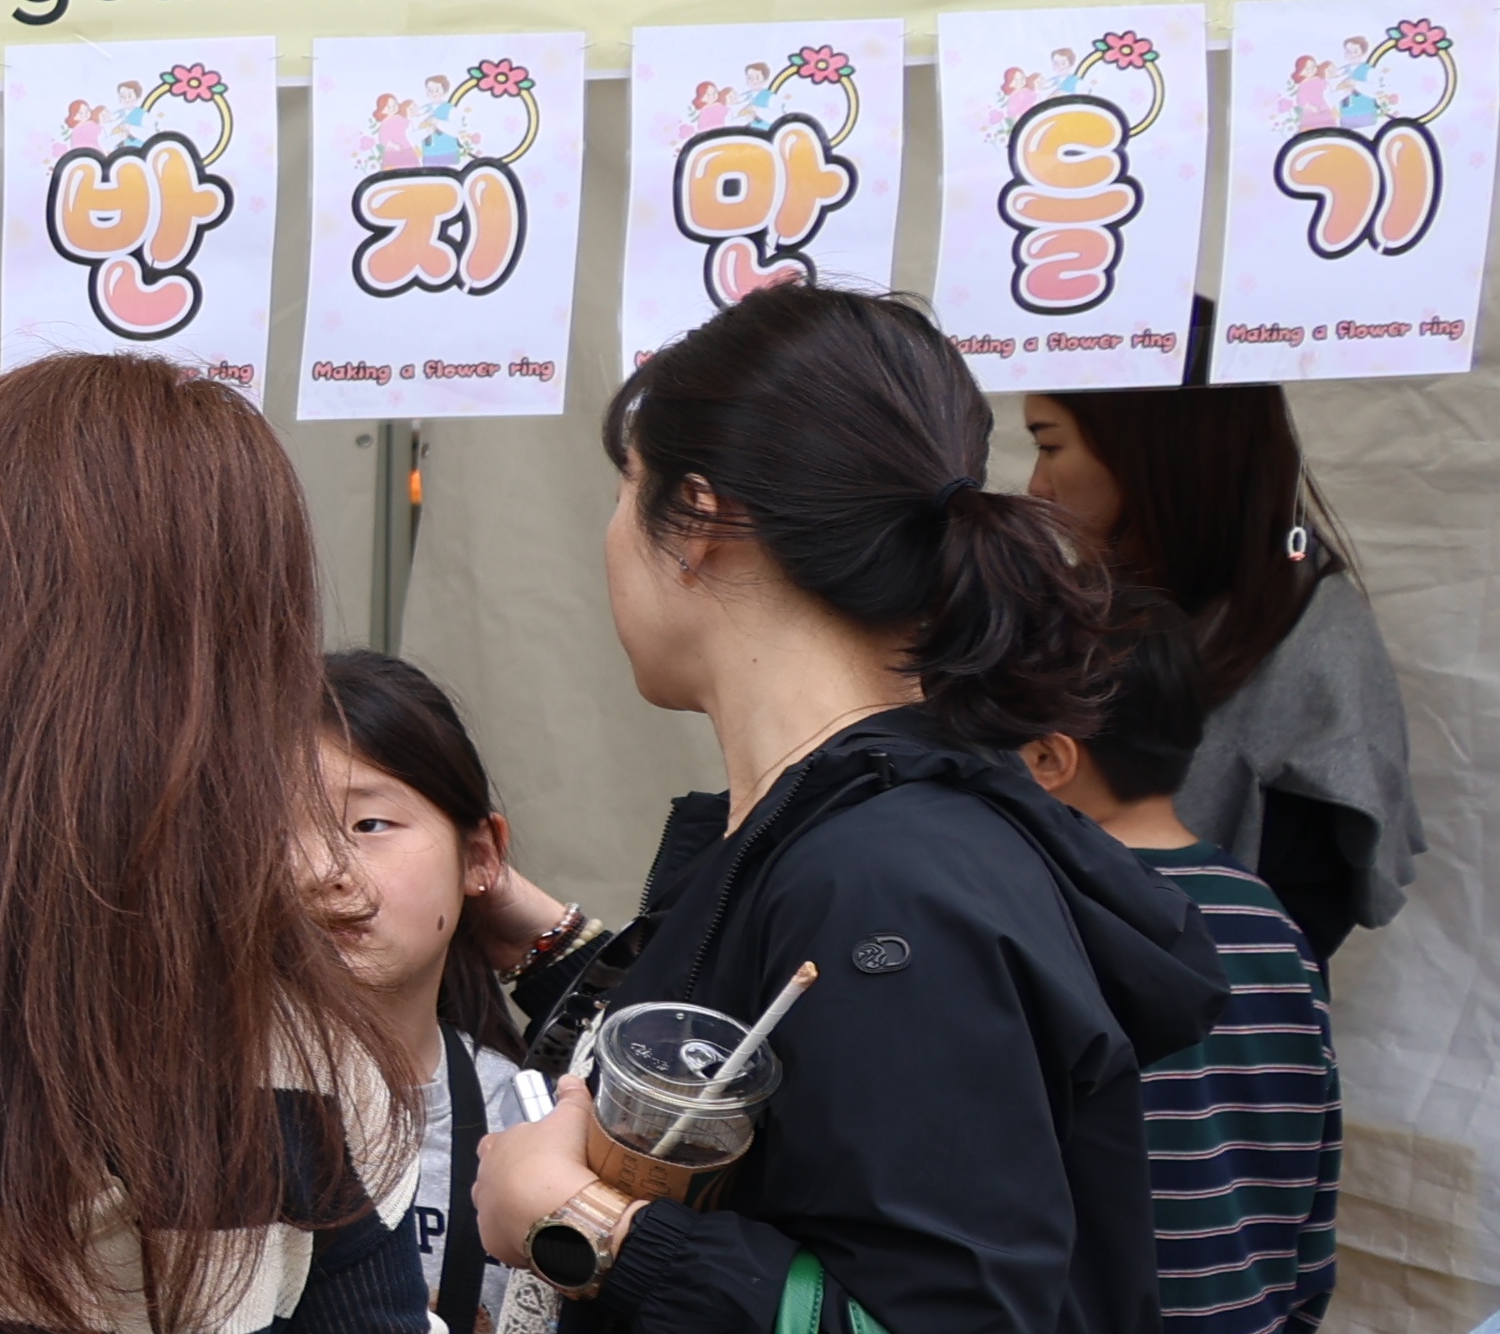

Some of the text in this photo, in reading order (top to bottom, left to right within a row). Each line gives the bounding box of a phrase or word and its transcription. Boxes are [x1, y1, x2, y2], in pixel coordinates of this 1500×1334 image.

[46, 131, 235, 340] 반
[352, 158, 528, 297] 지
[673, 114, 858, 311] 만
[998, 95, 1144, 315] 들
[1275, 117, 1441, 259] 기
[1023, 336, 1039, 352] a
[1047, 331, 1123, 351] flower
[1131, 328, 1177, 353] ring
[1227, 315, 1465, 345] Making a flower ring
[209, 360, 255, 385] ring
[312, 357, 555, 386] Making a flower ring
